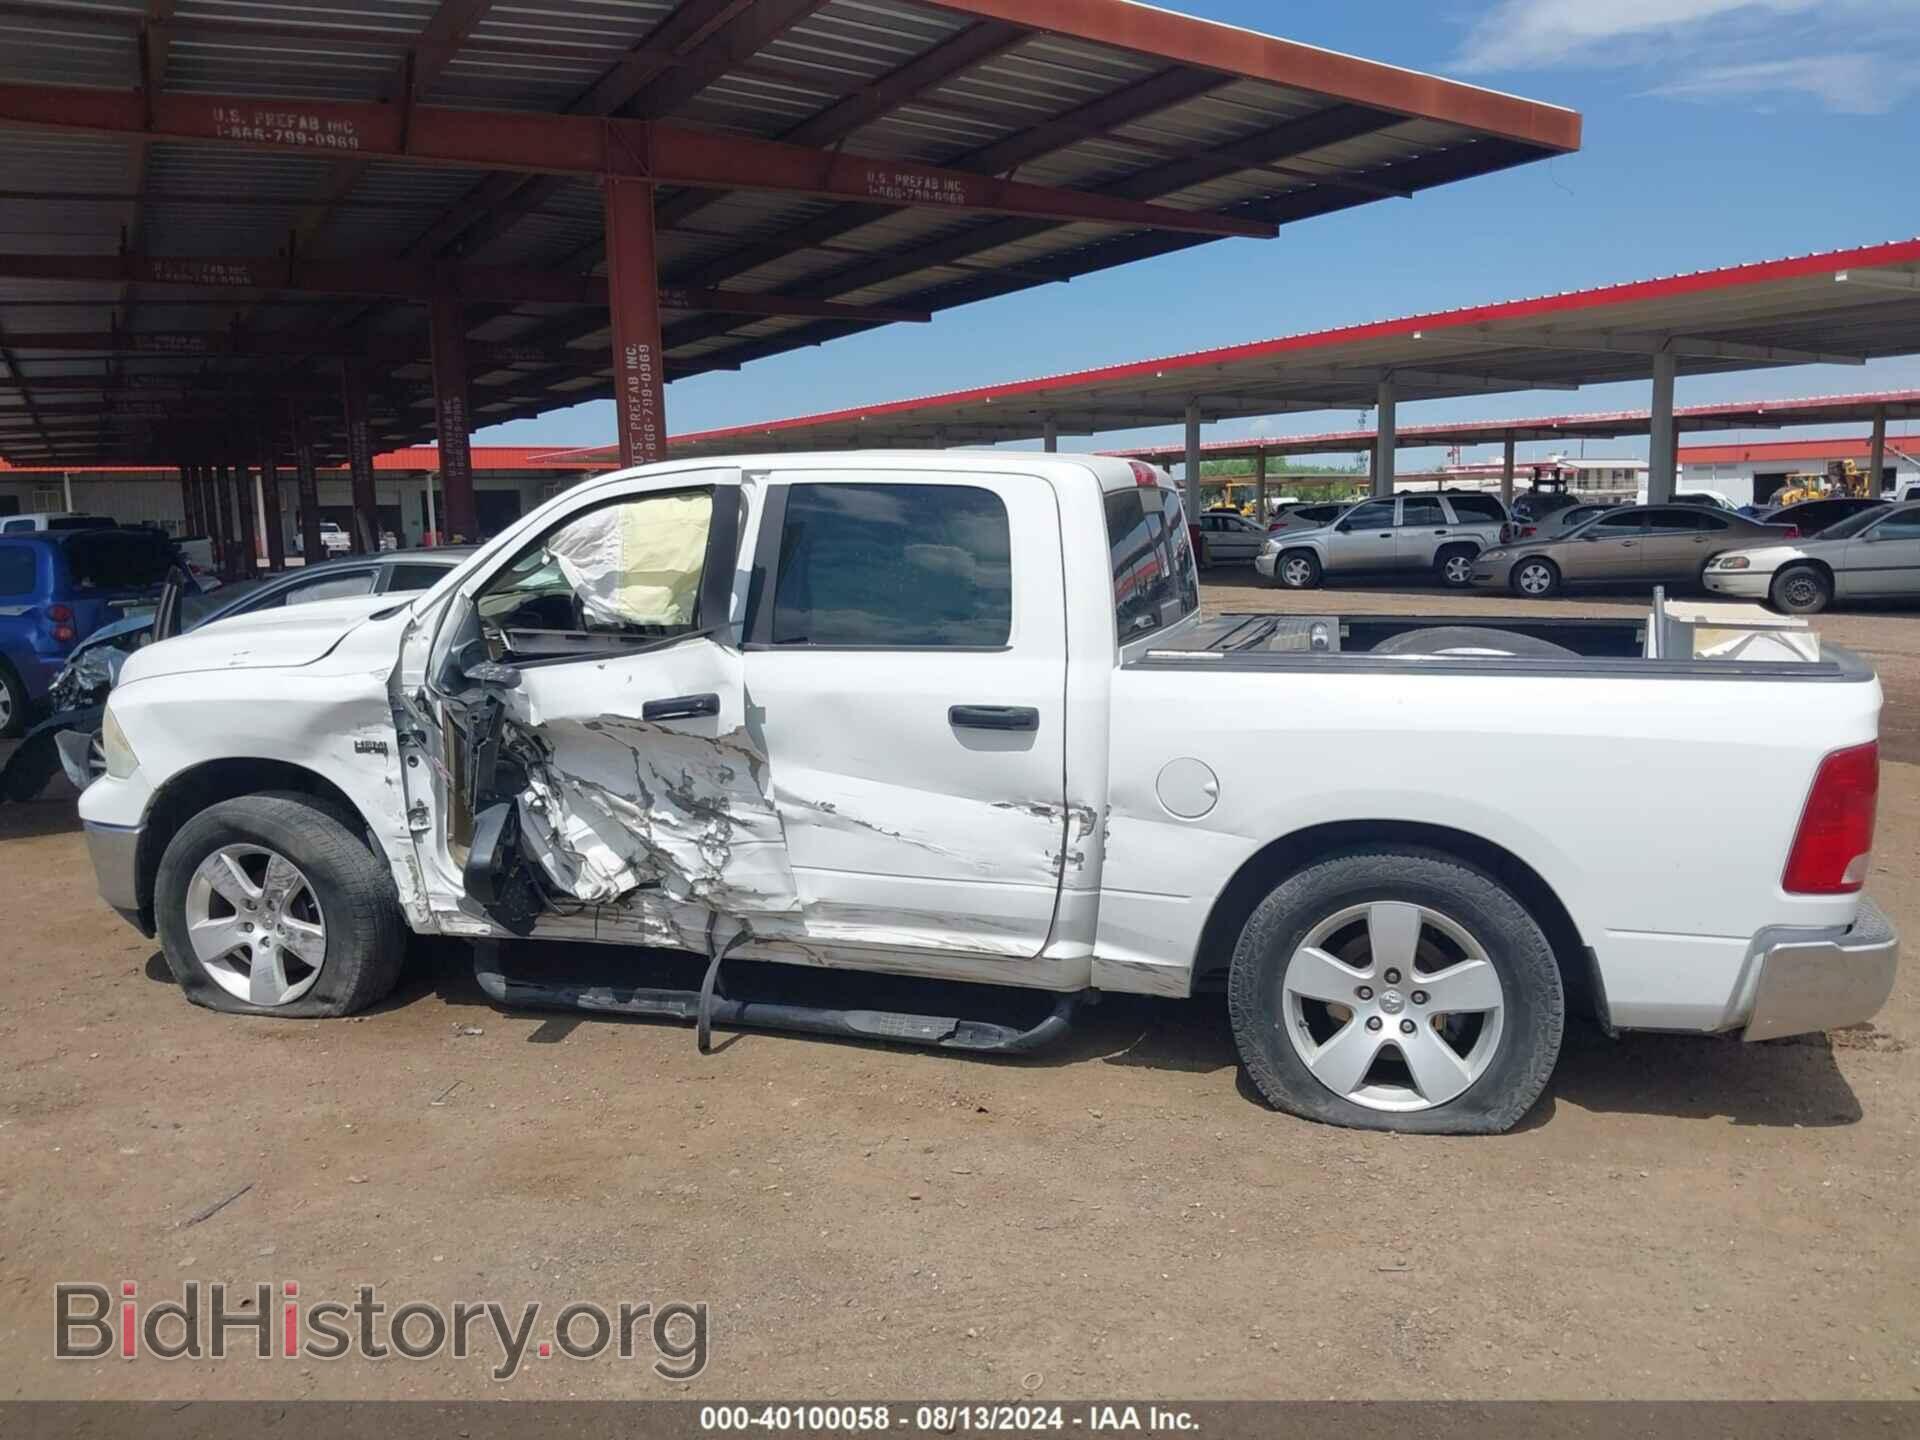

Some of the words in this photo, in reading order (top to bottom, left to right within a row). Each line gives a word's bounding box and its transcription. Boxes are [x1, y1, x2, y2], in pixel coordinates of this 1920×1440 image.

[213, 107, 246, 125] U.S.
[254, 112, 321, 131] PREFAB
[867, 170, 888, 185] U.S.
[895, 173, 940, 192] PREFAB
[625, 343, 638, 369] INC.
[627, 375, 642, 431] PREFAB
[638, 343, 657, 462] 1-866-799-0969
